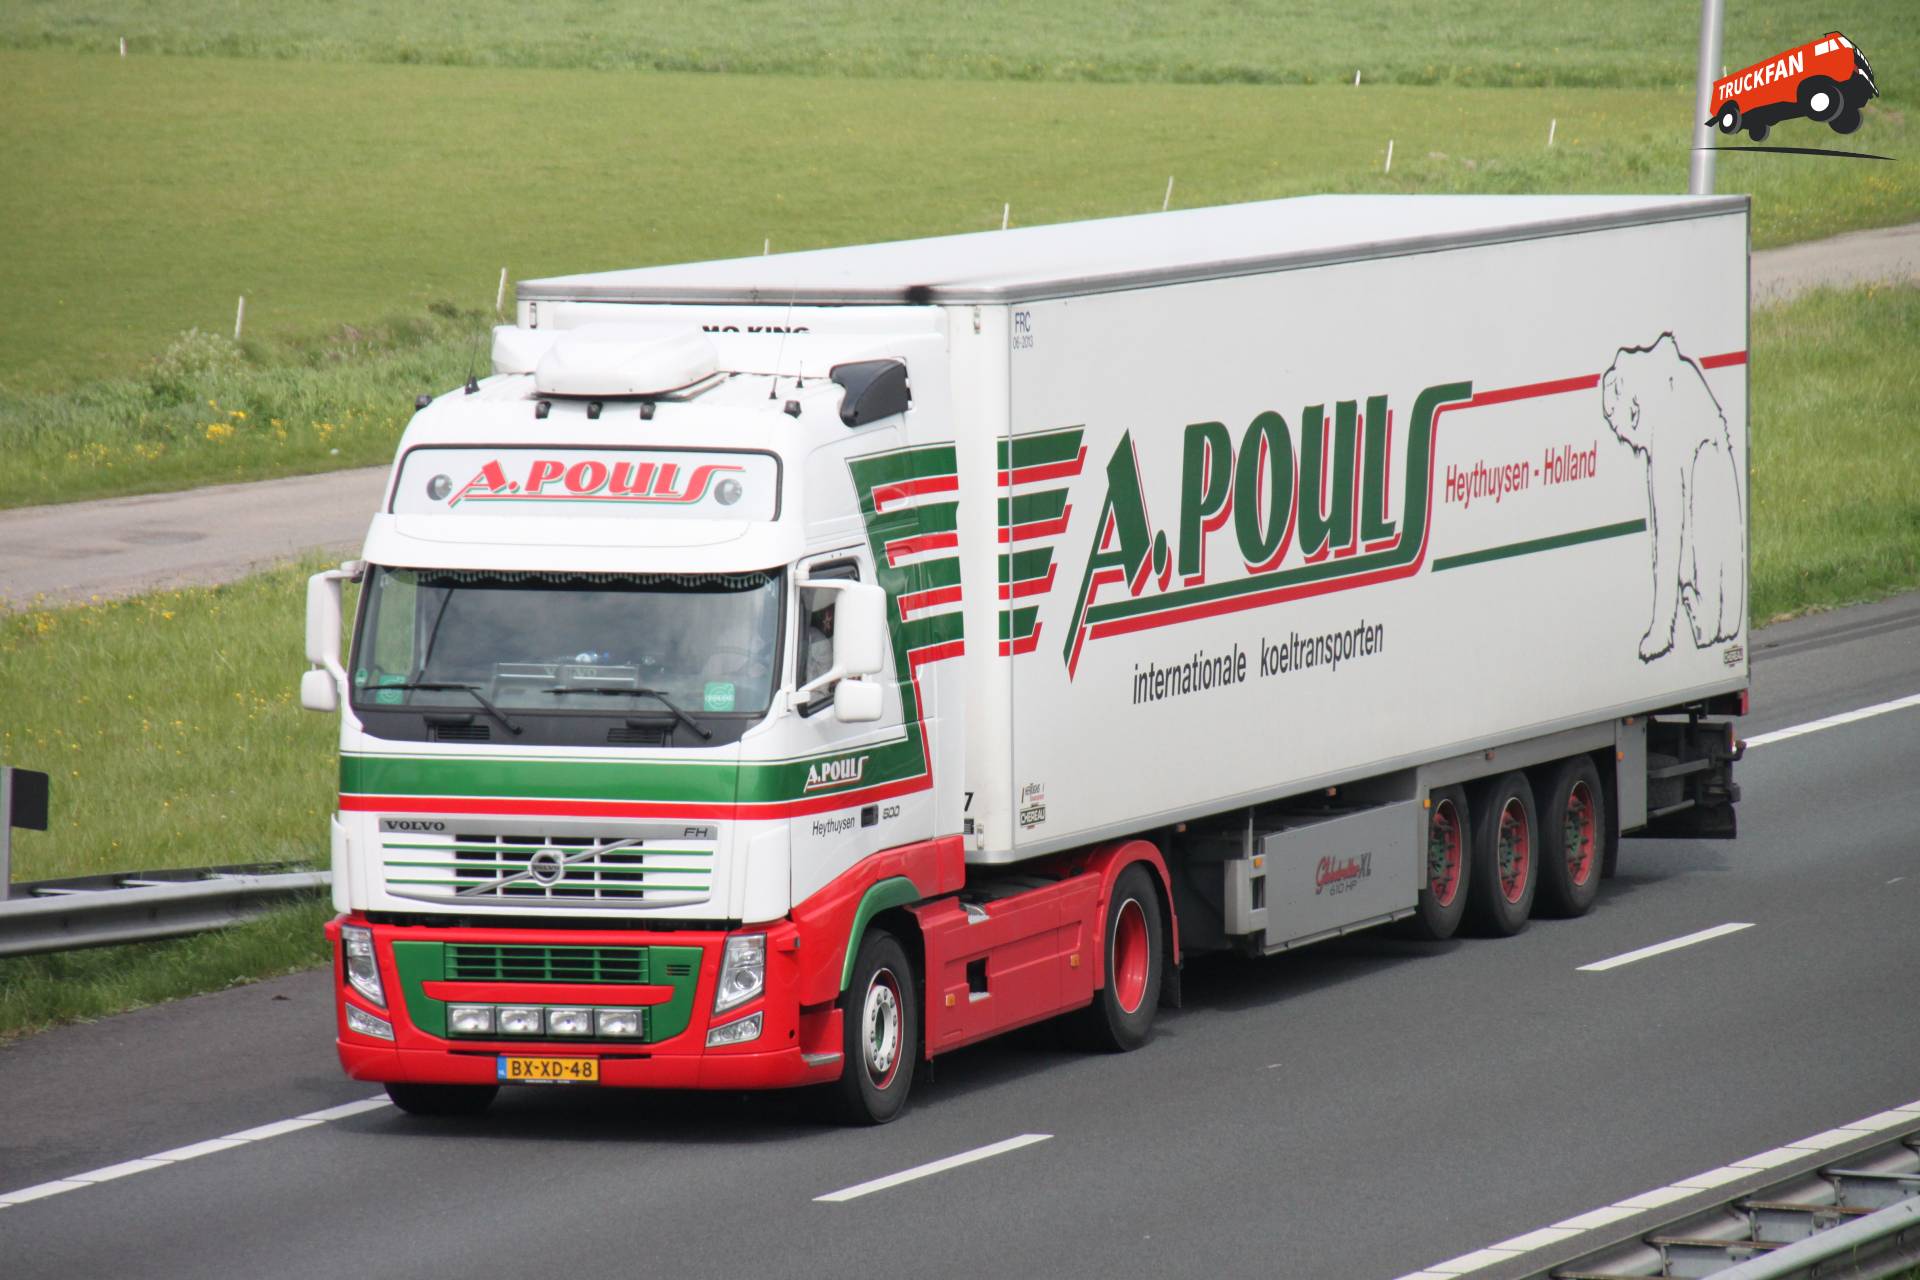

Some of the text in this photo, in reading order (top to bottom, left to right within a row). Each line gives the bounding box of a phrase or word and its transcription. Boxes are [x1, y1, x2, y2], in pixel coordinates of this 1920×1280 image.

[1015, 311, 1031, 333] FRC
[1445, 459, 1529, 510] Heythuysen
[1543, 439, 1598, 486] Holland
[1133, 619, 1384, 705] internationale koeltransporten
[386, 820, 446, 832] VOLVO
[683, 827, 708, 838] FH
[812, 816, 855, 838] Heythuysen
[511, 1060, 593, 1078] BX-XD-48
